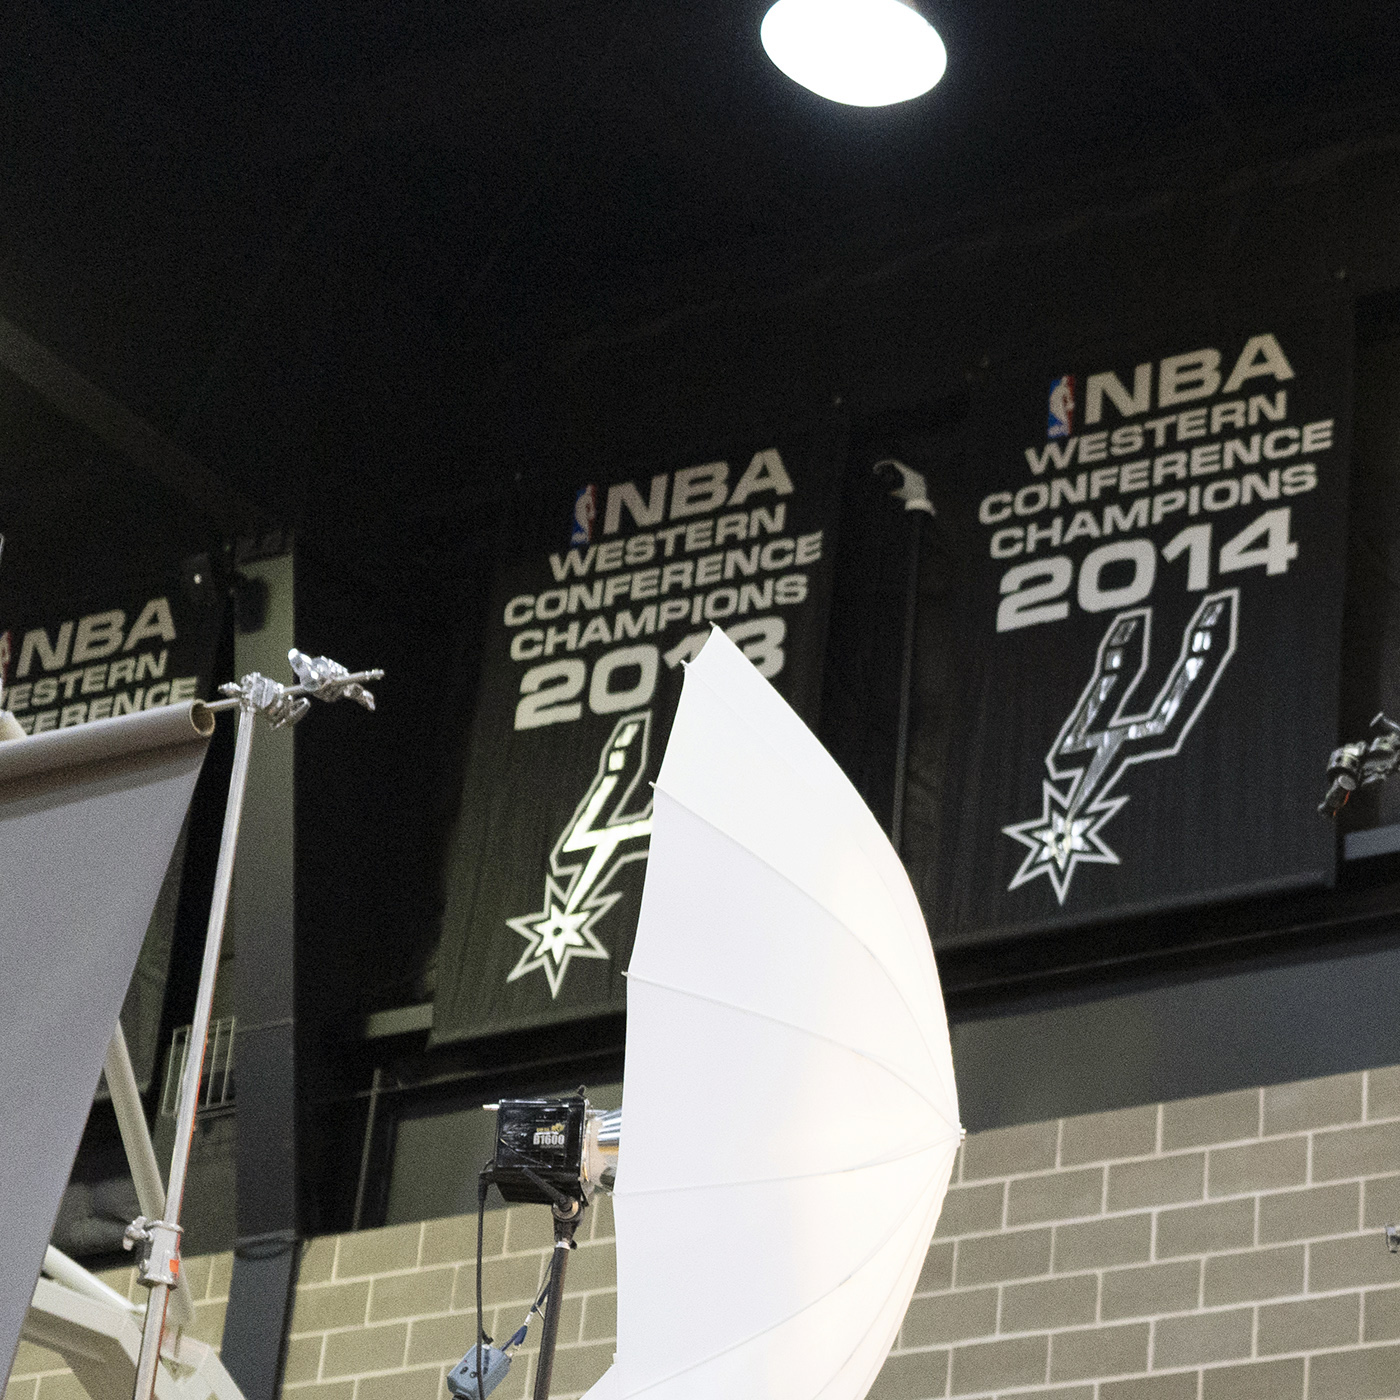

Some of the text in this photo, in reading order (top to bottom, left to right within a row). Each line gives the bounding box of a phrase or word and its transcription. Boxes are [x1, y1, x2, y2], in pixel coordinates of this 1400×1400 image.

[1085, 333, 1295, 425] NBA
[979, 418, 1334, 524] CONFERENCE
[1025, 390, 1287, 475] WESTERN
[603, 448, 795, 534] NBA
[989, 462, 1318, 559] CHAMPIONS
[503, 531, 823, 628] CONFERENCE
[549, 502, 786, 581] WESTERN
[996, 507, 1298, 633] 2014
[16, 597, 176, 678] NBA
[510, 574, 808, 661] CHAMPIONS
[1, 650, 168, 713] ESTERN
